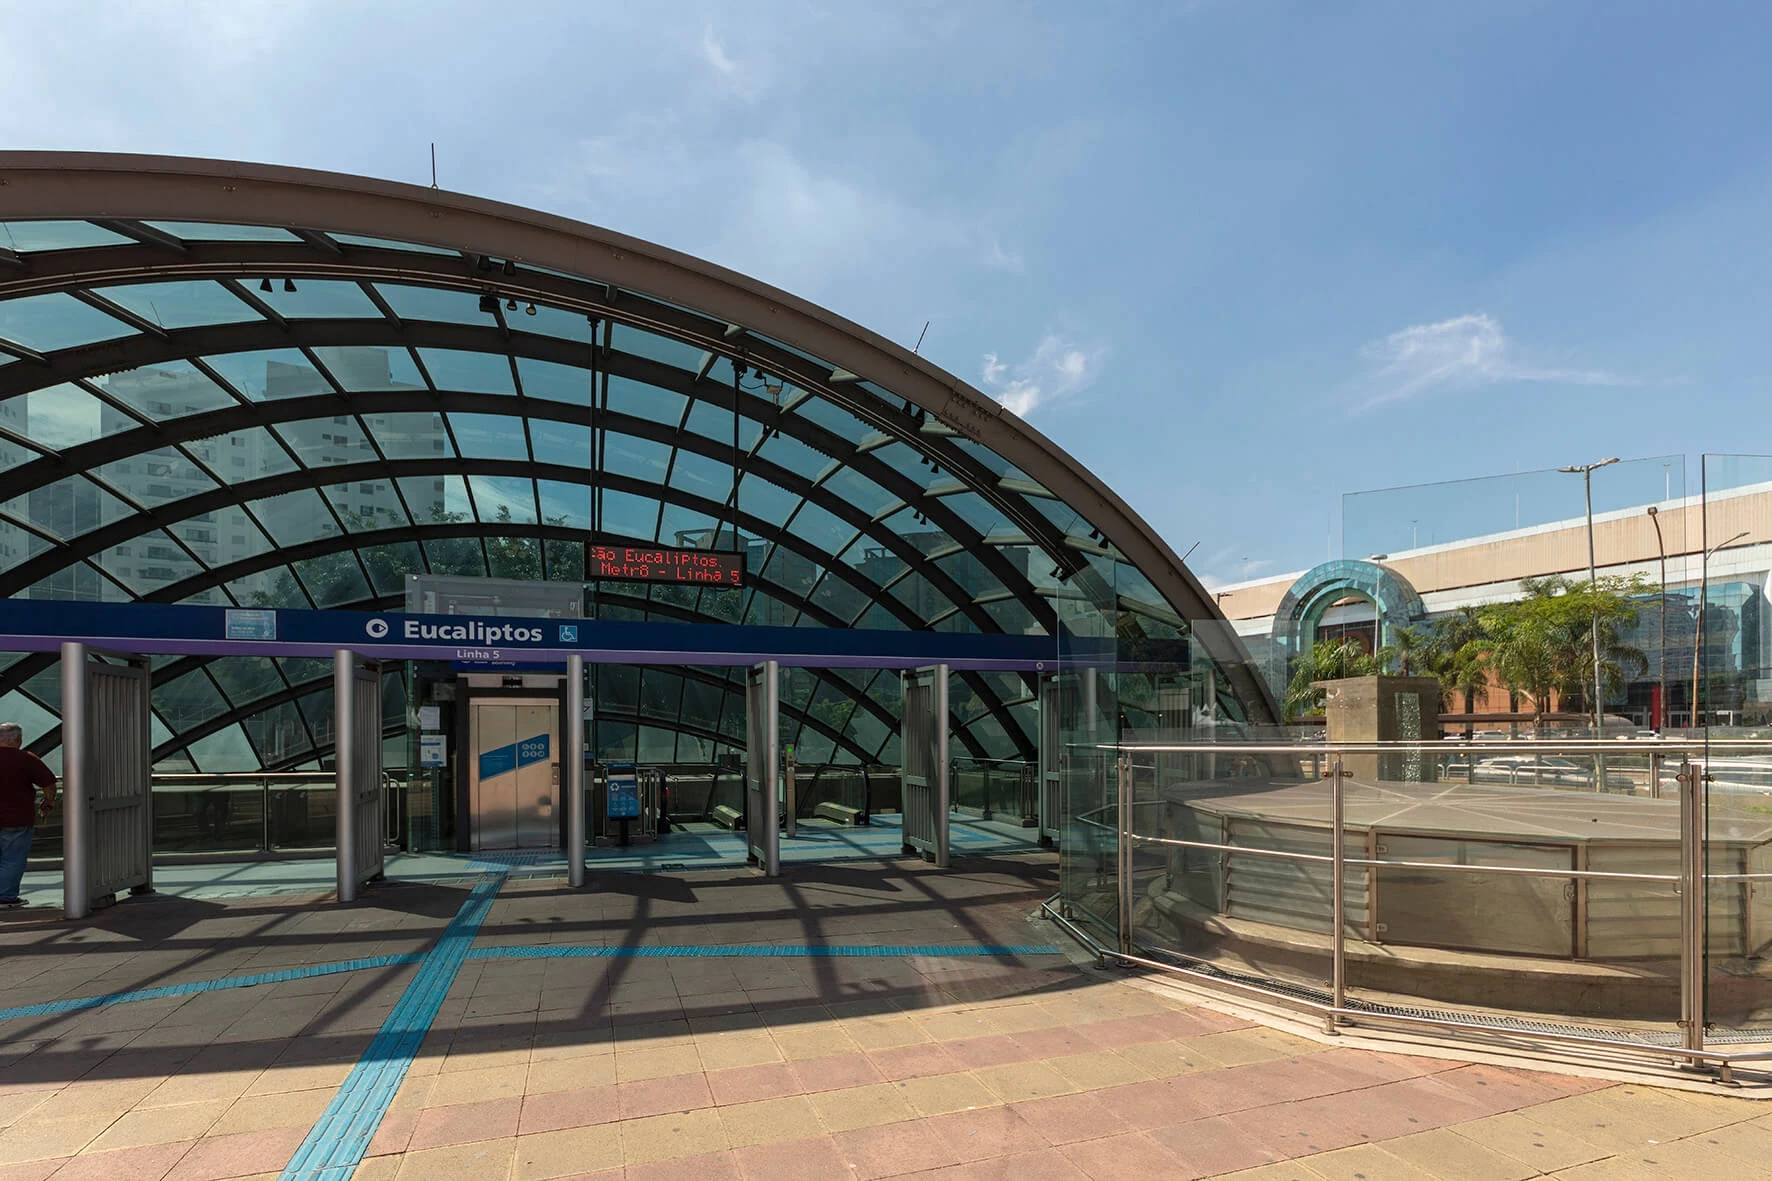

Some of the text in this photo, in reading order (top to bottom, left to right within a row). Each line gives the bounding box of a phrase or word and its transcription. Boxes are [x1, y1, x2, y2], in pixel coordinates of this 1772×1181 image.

[676, 566, 722, 583] Linha
[730, 570, 740, 583] 5
[404, 621, 543, 645] Eucaliptos
[456, 649, 500, 660] Linha 5
